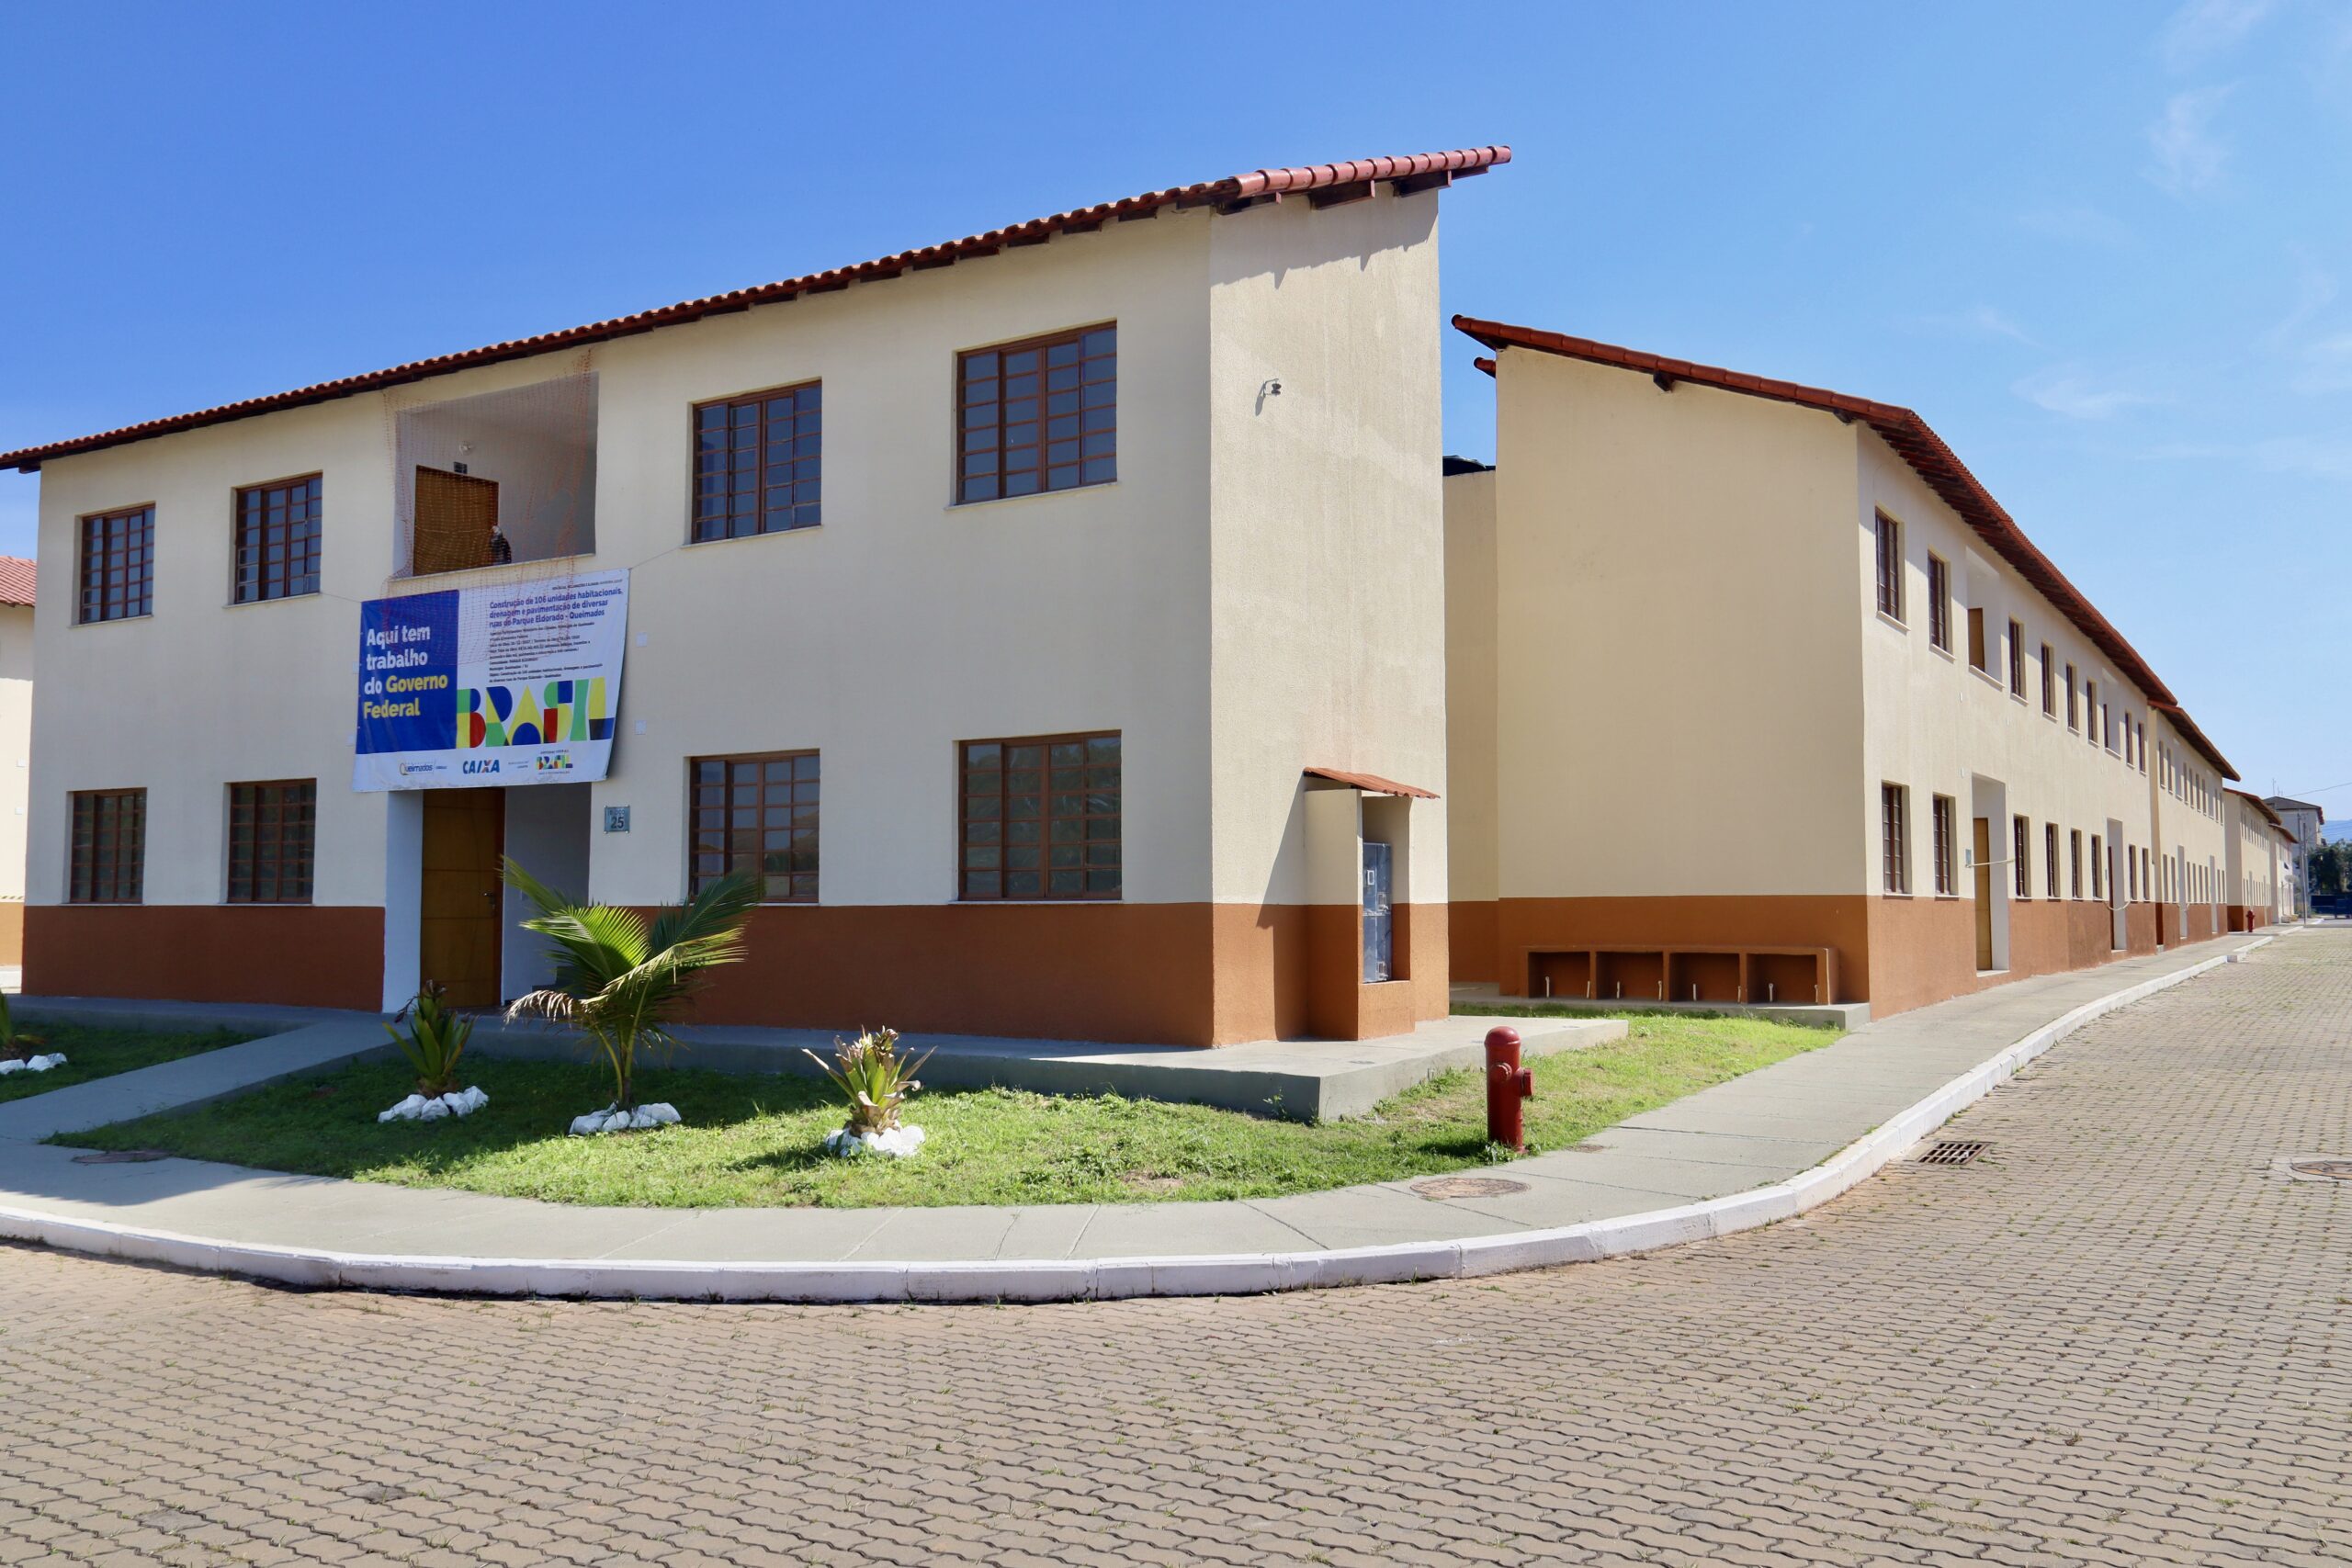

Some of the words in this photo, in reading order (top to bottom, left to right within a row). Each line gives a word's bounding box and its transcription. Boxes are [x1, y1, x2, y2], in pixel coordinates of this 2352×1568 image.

[490, 598, 524, 609] Construção
[526, 596, 534, 604] de
[548, 592, 577, 603] unidades
[526, 602, 571, 616] pavimentação
[571, 601, 581, 610] de
[582, 600, 608, 609] diversas
[513, 616, 534, 626] Parque
[536, 613, 564, 623] Eldorado
[570, 608, 605, 619] Queimados
[366, 626, 399, 649] Aqui
[401, 626, 431, 642] tem
[366, 649, 428, 671] trabalho
[364, 677, 382, 694] do
[386, 675, 448, 693] Governo
[364, 697, 421, 719] Federal
[455, 676, 616, 750] BRASIL
[400, 763, 434, 776] Queimados
[462, 760, 500, 774] CAIXA
[610, 817, 625, 829] 25
